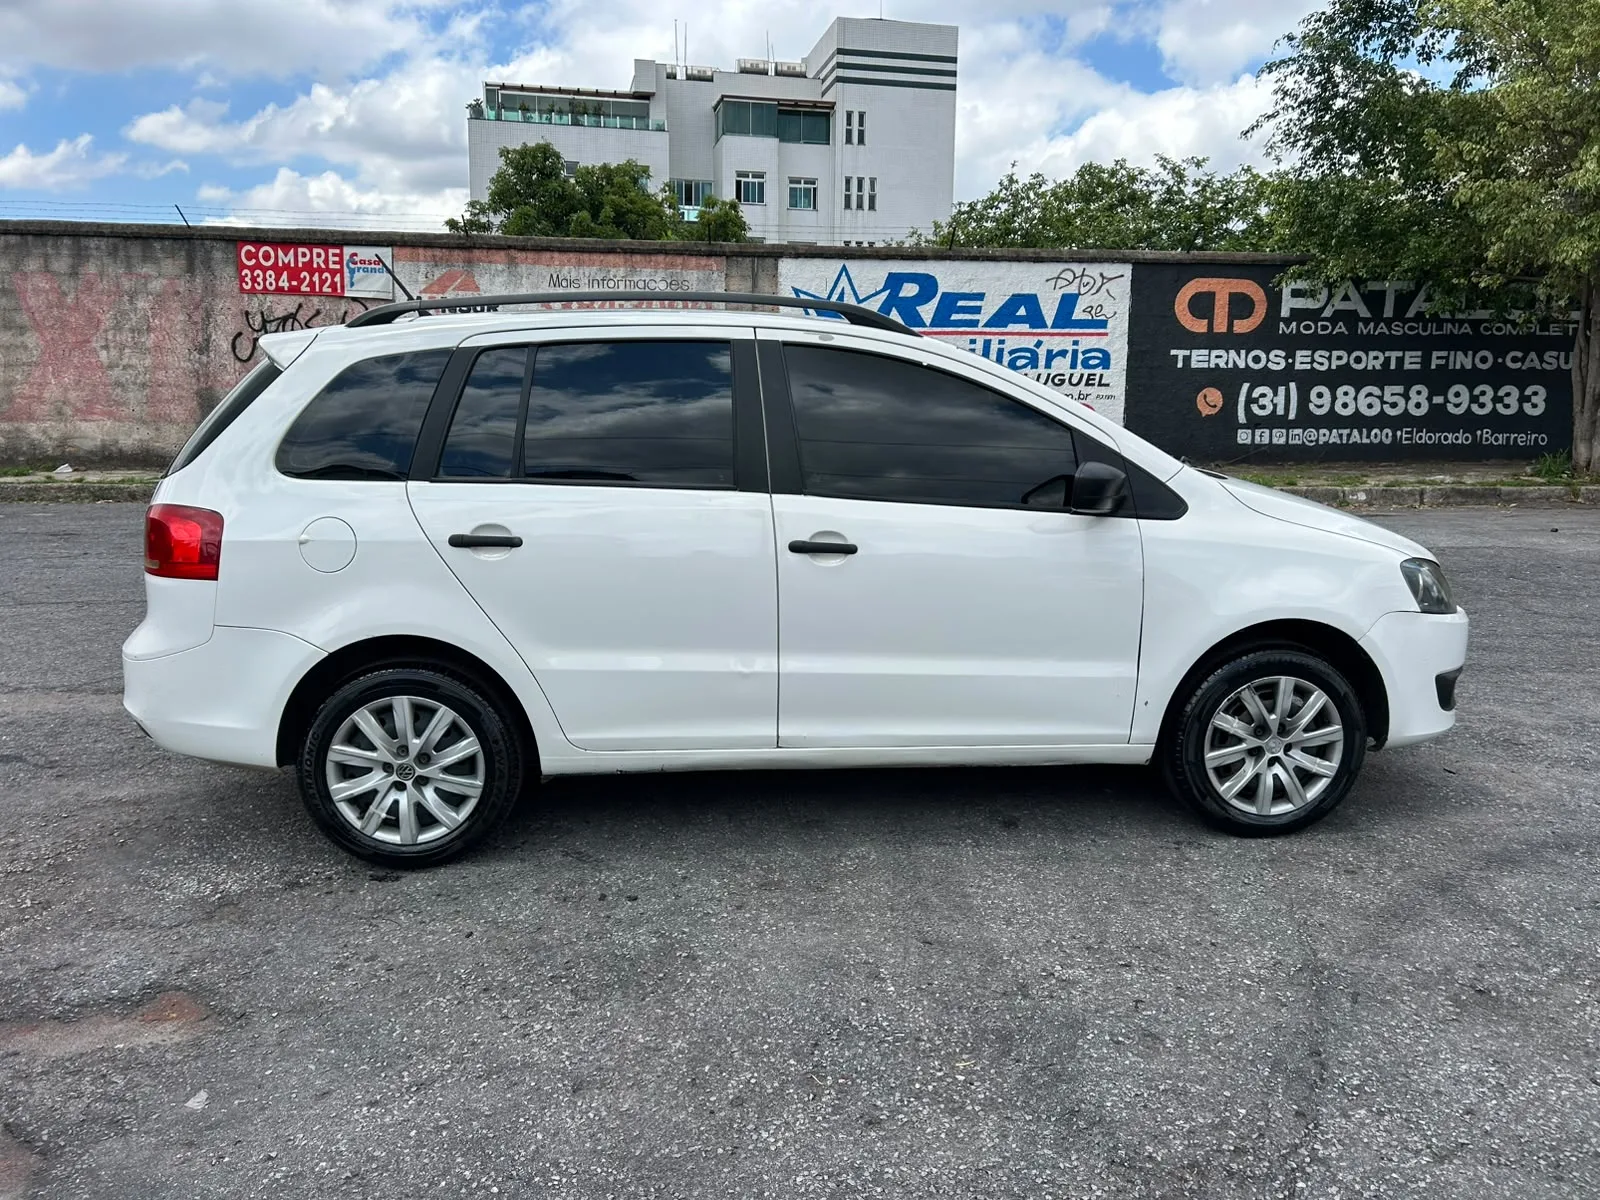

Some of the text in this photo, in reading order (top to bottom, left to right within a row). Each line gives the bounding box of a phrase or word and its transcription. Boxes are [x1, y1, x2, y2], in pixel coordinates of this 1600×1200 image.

[240, 245, 341, 270] COMPRE
[241, 269, 341, 293] 3384-2121
[548, 273, 580, 289] Mais
[878, 272, 1108, 329] REAL
[1279, 321, 1591, 337] MODA MASCULINA COMPLET
[1023, 373, 1110, 387] UGUEL
[1237, 382, 1548, 424] (31) 98658-9333
[1402, 428, 1472, 445] Eldorado
[1482, 430, 1548, 447] Barreiro
